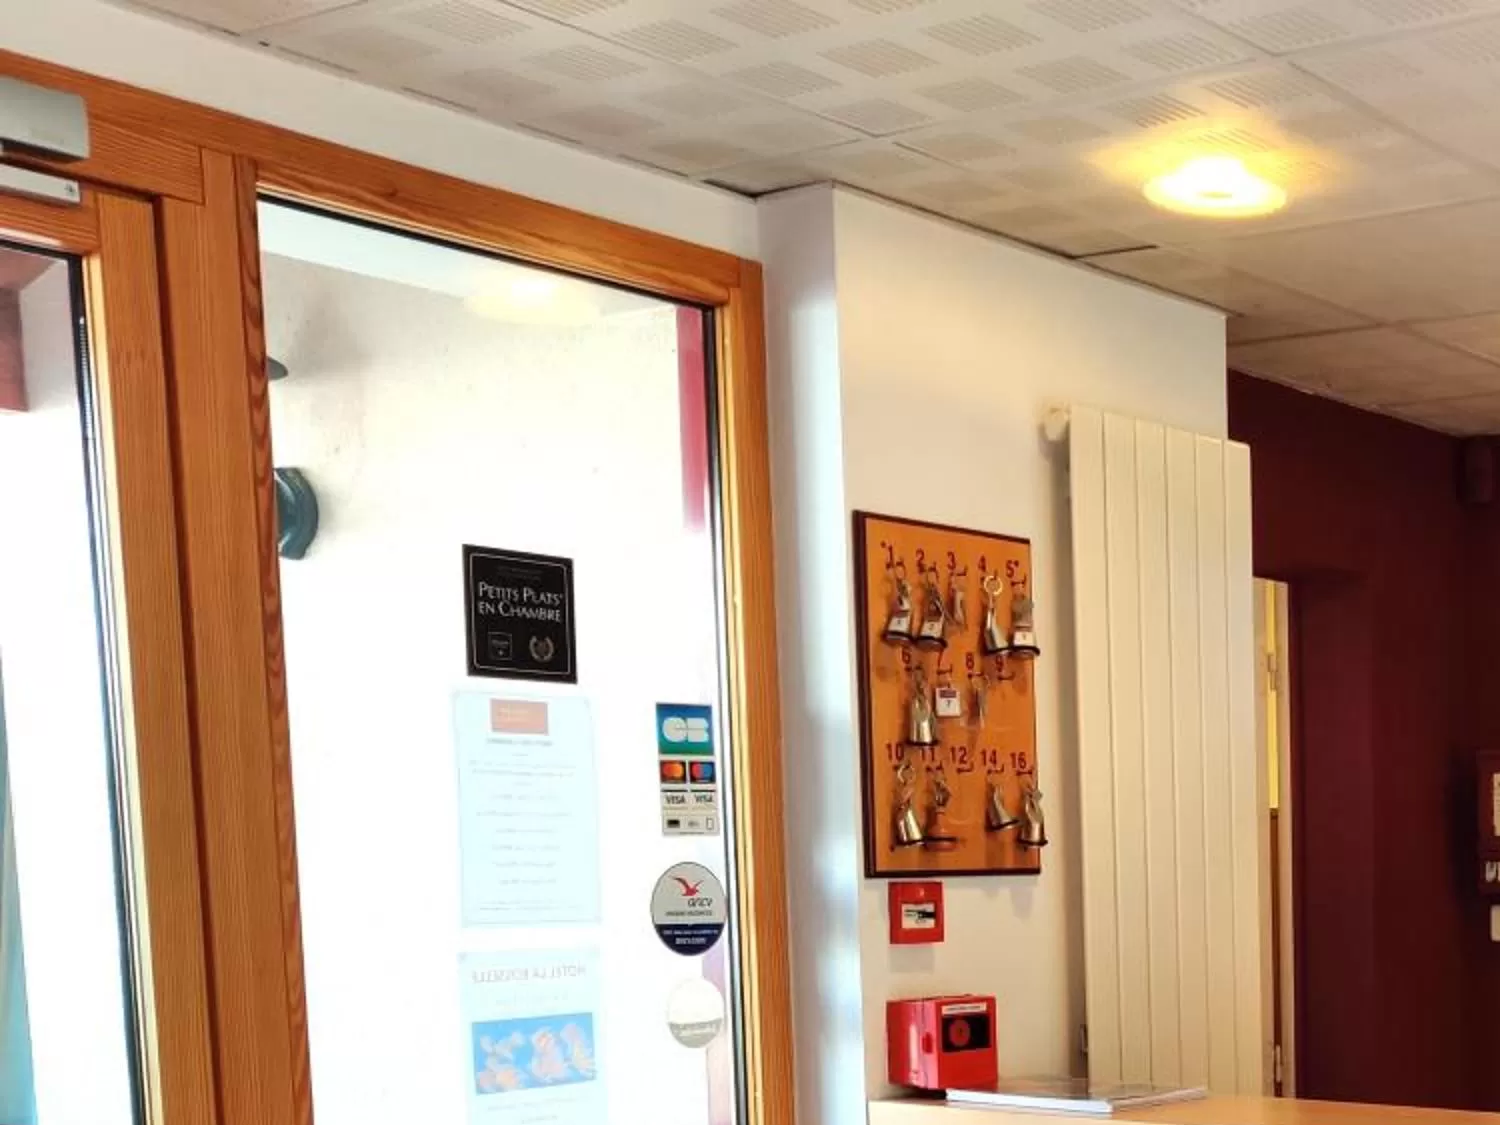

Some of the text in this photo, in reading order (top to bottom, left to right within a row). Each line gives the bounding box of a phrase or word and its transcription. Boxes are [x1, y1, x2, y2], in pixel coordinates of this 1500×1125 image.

[947, 551, 956, 568] 3
[978, 555, 987, 571] 4
[1006, 559, 1015, 577] 5
[479, 581, 560, 606] PETITS PLATS
[479, 601, 561, 622] EN CHAMBRE
[966, 652, 975, 670] 8
[886, 742, 1027, 769] 10 11 12 14 16
[665, 793, 714, 805] VISA VISA
